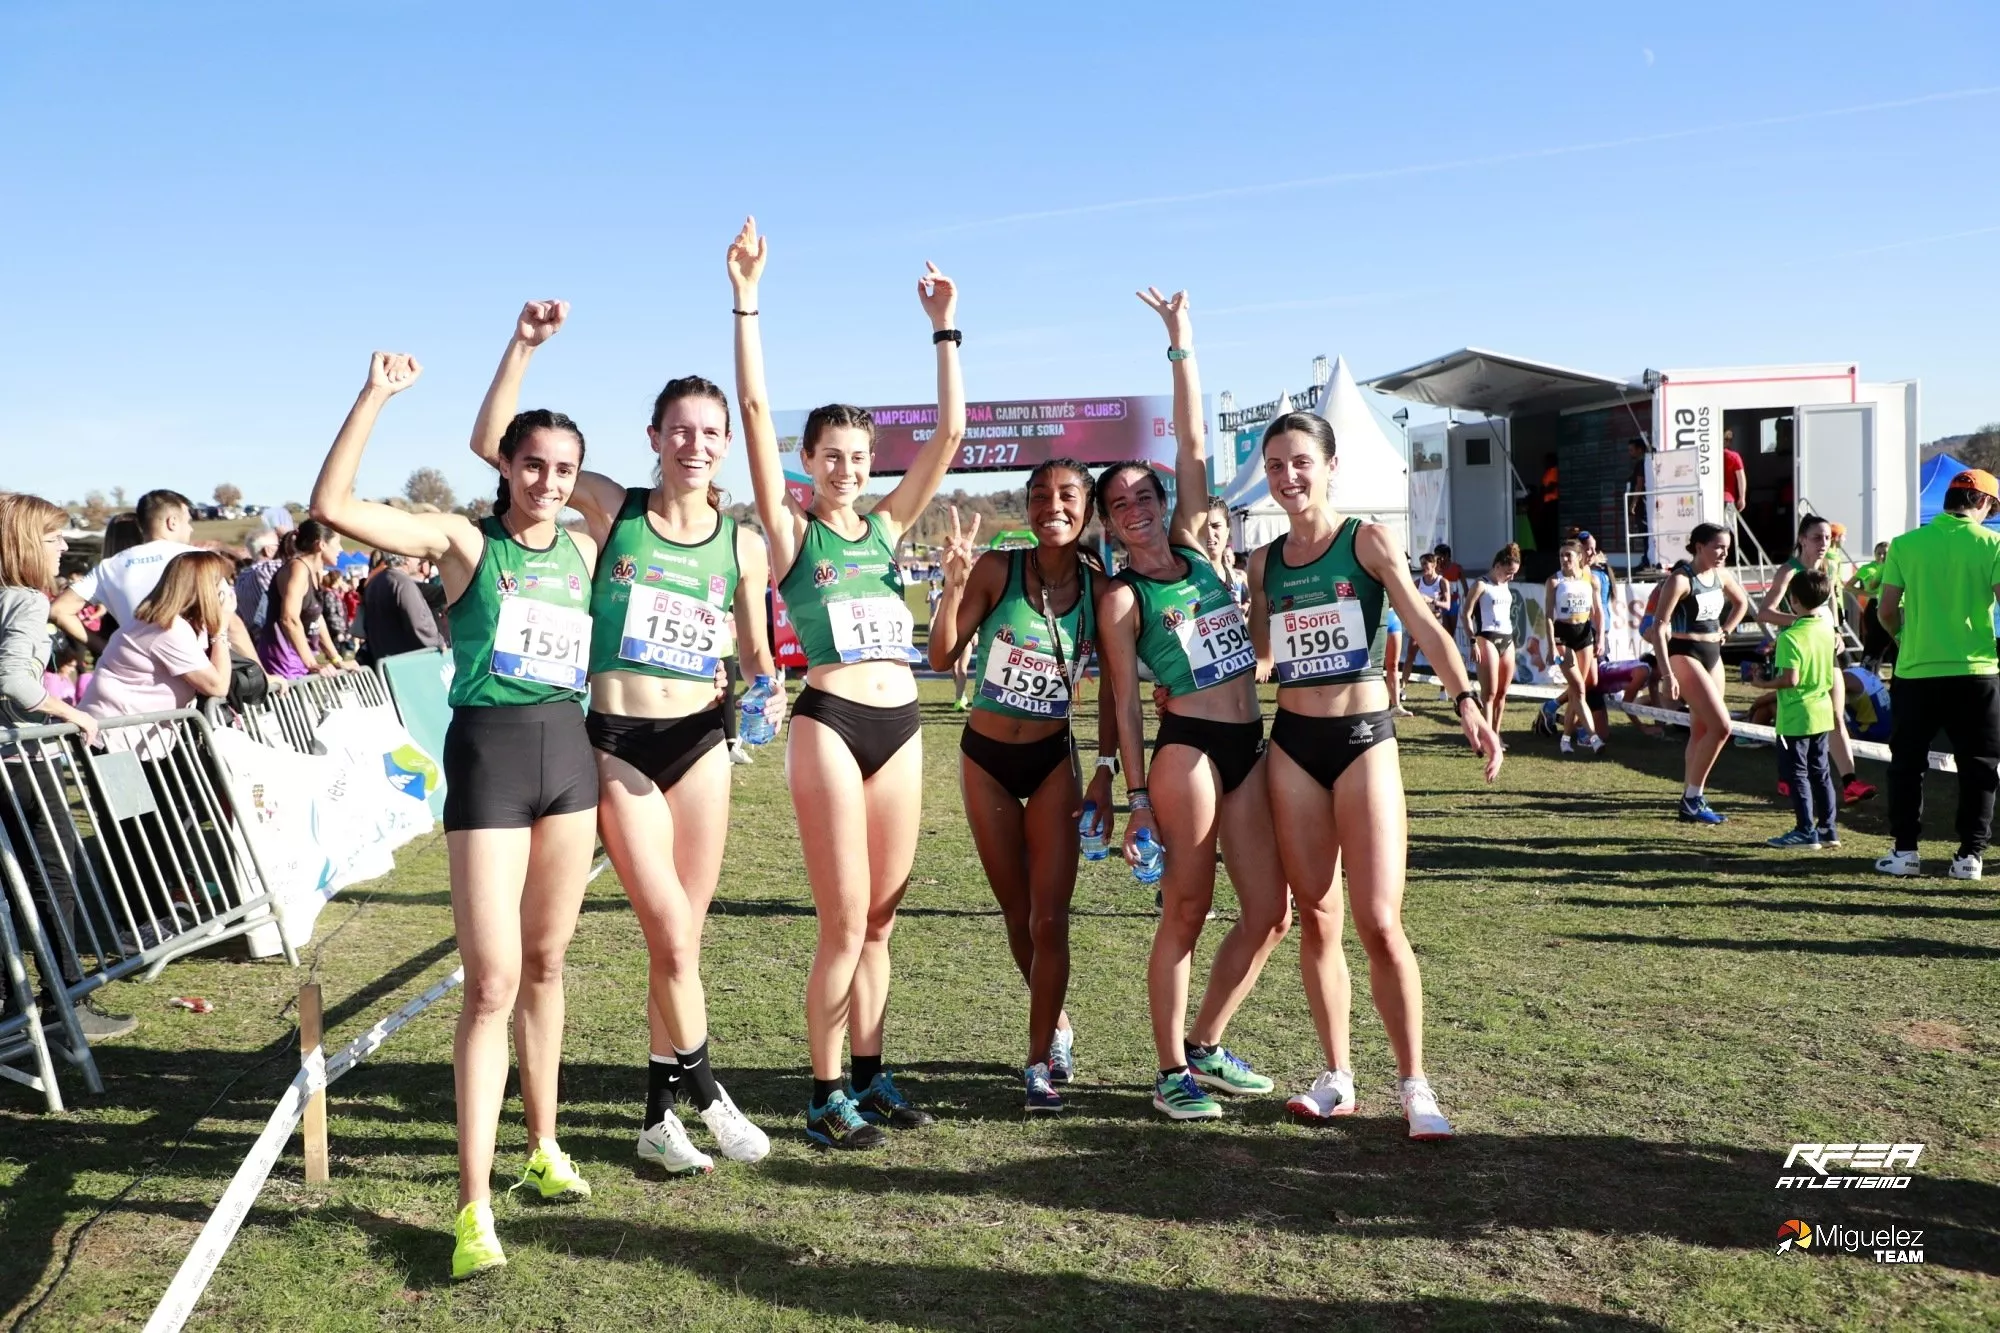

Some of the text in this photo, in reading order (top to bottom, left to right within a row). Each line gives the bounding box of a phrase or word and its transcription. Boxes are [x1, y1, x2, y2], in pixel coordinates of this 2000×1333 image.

[996, 406, 1029, 420] CAMPO
[1031, 406, 1039, 419] A
[1040, 402, 1075, 418] TRAVÉS
[1084, 403, 1121, 417] CLUBES
[1022, 425, 1034, 436] DE
[1037, 424, 1065, 436] SORIA
[1698, 406, 1710, 475] eventos
[963, 444, 1019, 465] 37:27
[669, 600, 716, 626] Soria
[1209, 613, 1240, 632] Soria
[1298, 613, 1341, 630] Soria
[519, 628, 581, 663] 1591
[646, 615, 716, 652] 1595
[1286, 627, 1349, 657] 1596
[640, 643, 704, 671] Joma
[1290, 654, 1350, 679] Joma
[1001, 667, 1063, 699] 1592
[996, 689, 1053, 714] Joma
